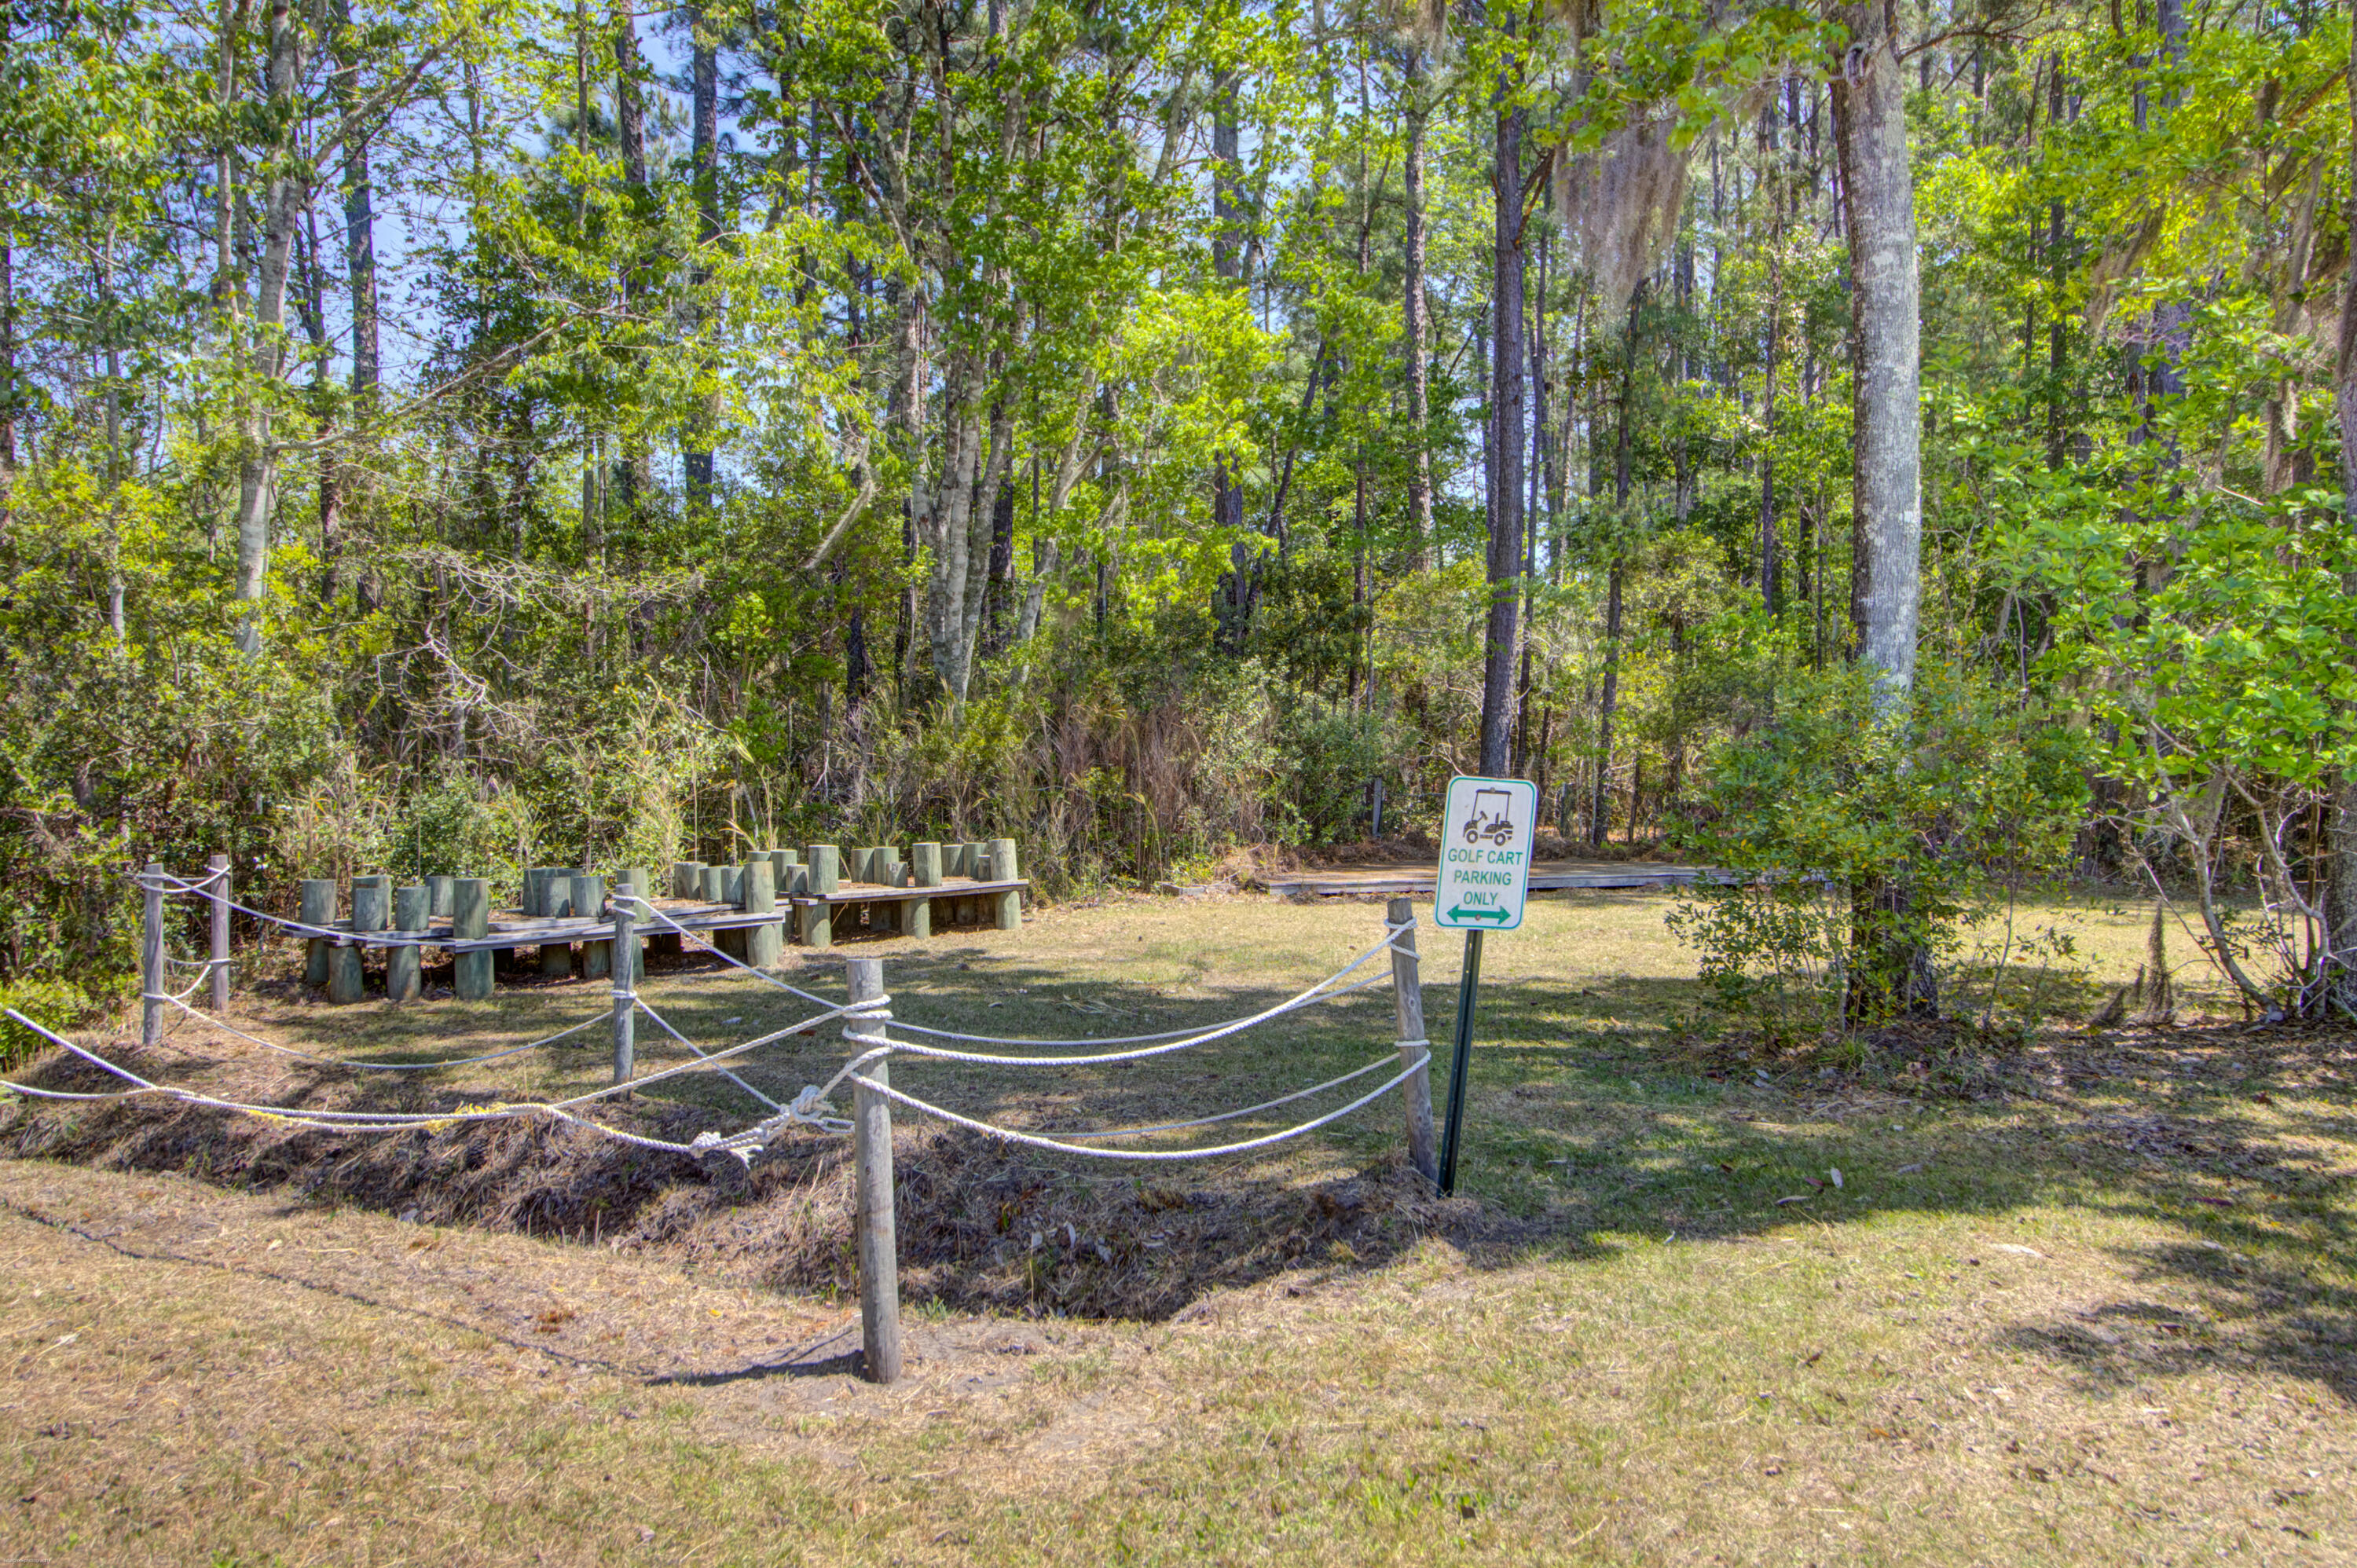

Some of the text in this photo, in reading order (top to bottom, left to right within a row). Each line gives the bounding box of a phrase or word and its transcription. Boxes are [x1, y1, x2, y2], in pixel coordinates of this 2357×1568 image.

[1448, 848, 1523, 865] GOLF CART
[1453, 870, 1512, 885] PARKING
[1464, 891, 1498, 905] ONLY
